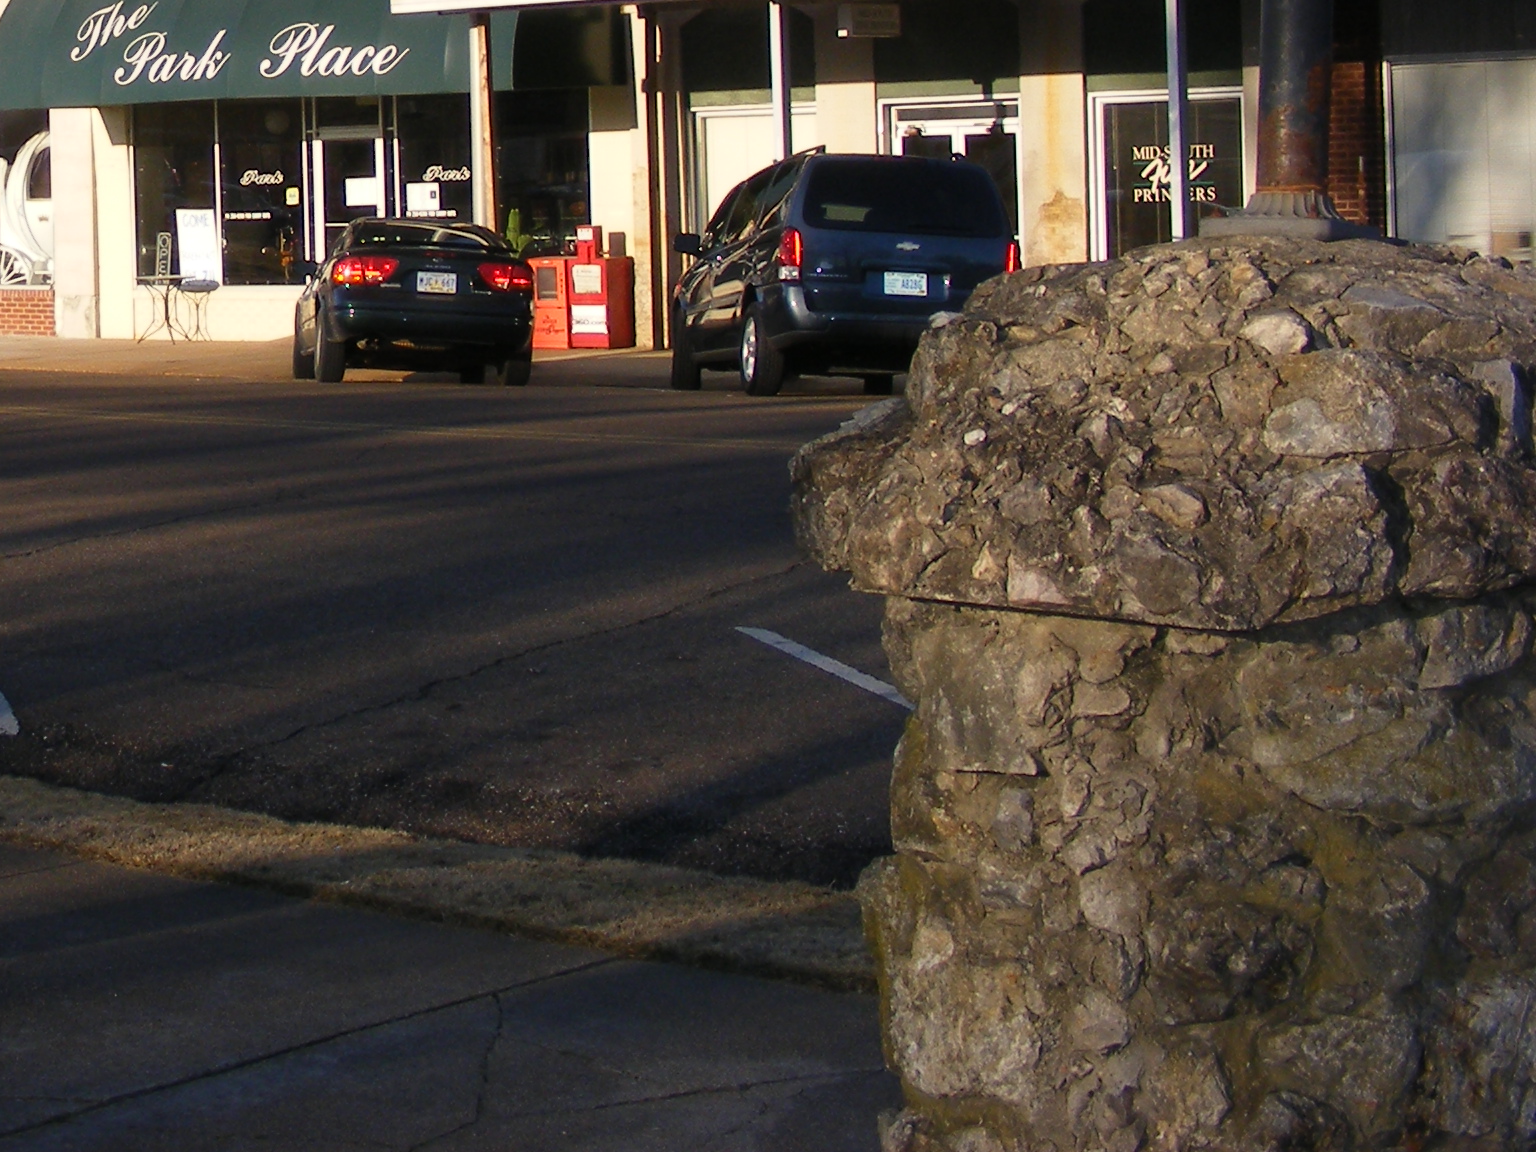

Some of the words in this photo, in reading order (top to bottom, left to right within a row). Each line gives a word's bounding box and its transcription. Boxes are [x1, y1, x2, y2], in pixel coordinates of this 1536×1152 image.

[70, 0, 159, 62] The
[114, 29, 231, 86] Park
[259, 22, 410, 79] Place
